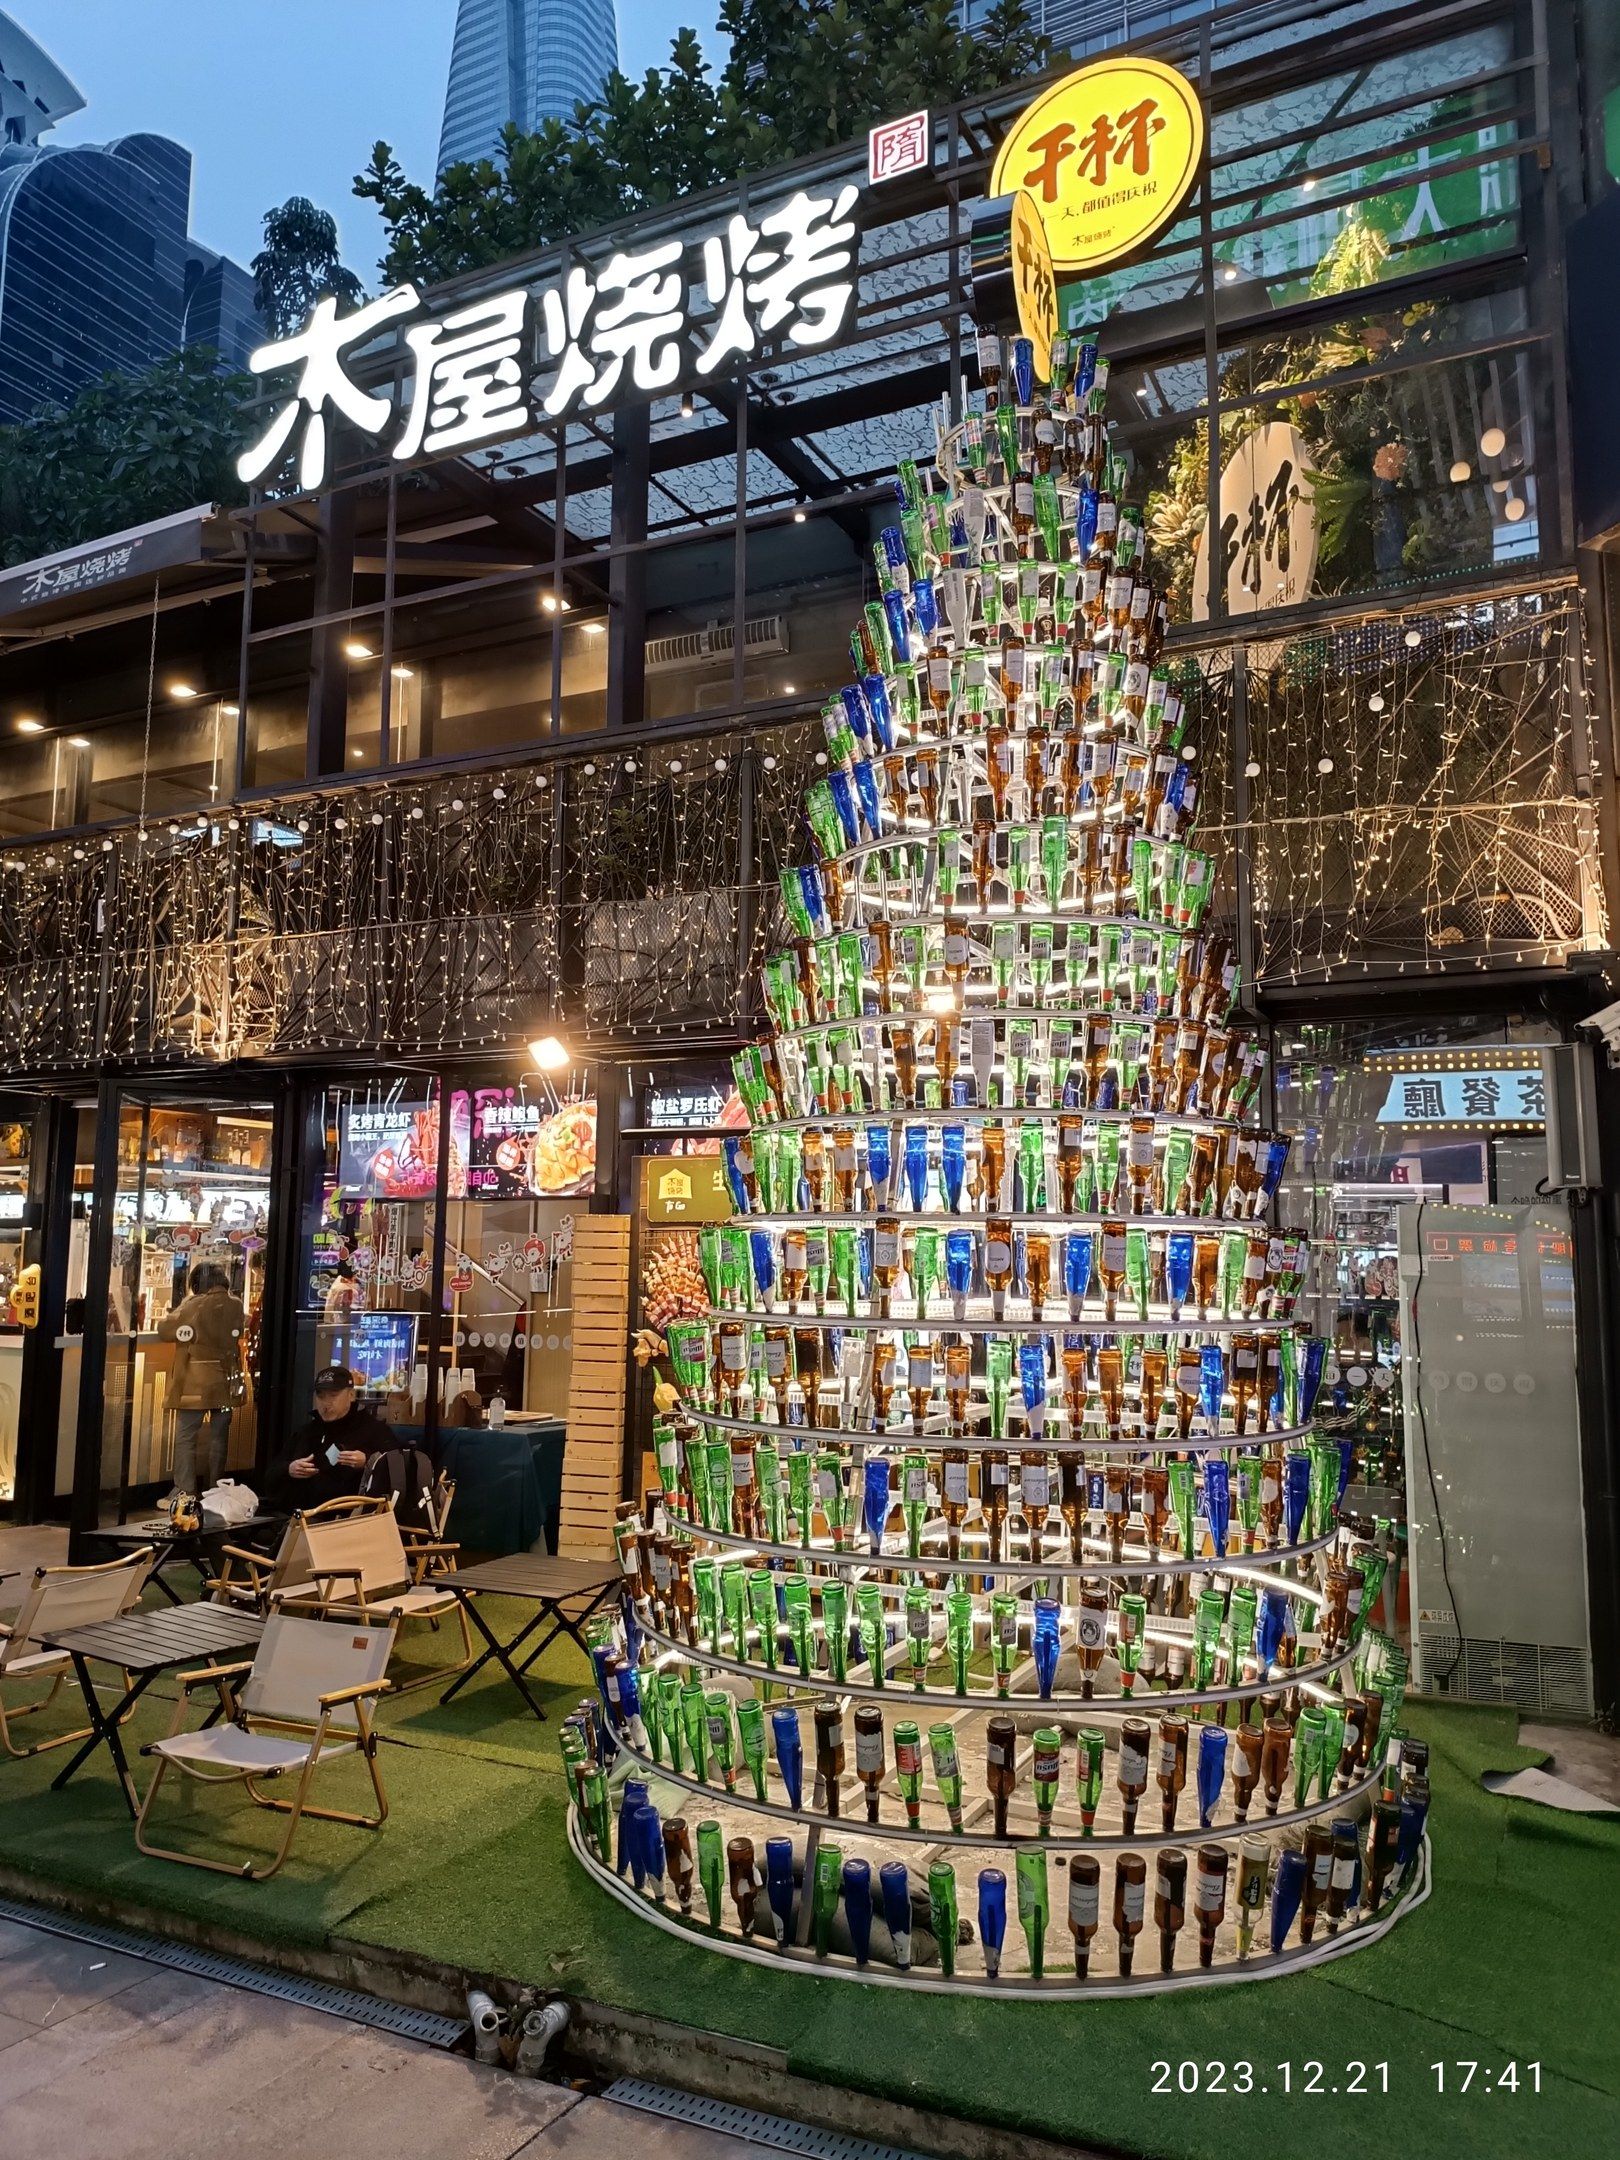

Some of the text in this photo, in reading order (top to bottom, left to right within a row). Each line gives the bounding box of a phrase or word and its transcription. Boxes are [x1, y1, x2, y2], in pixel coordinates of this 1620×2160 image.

[1023, 98, 1166, 203] 干杯
[238, 183, 859, 490] 木屋烧烤
[22, 547, 132, 594] 木屋烧烤
[484, 1105, 540, 1124] 香辣鲍鱼
[651, 1097, 722, 1115] 椒盐罗氏虾
